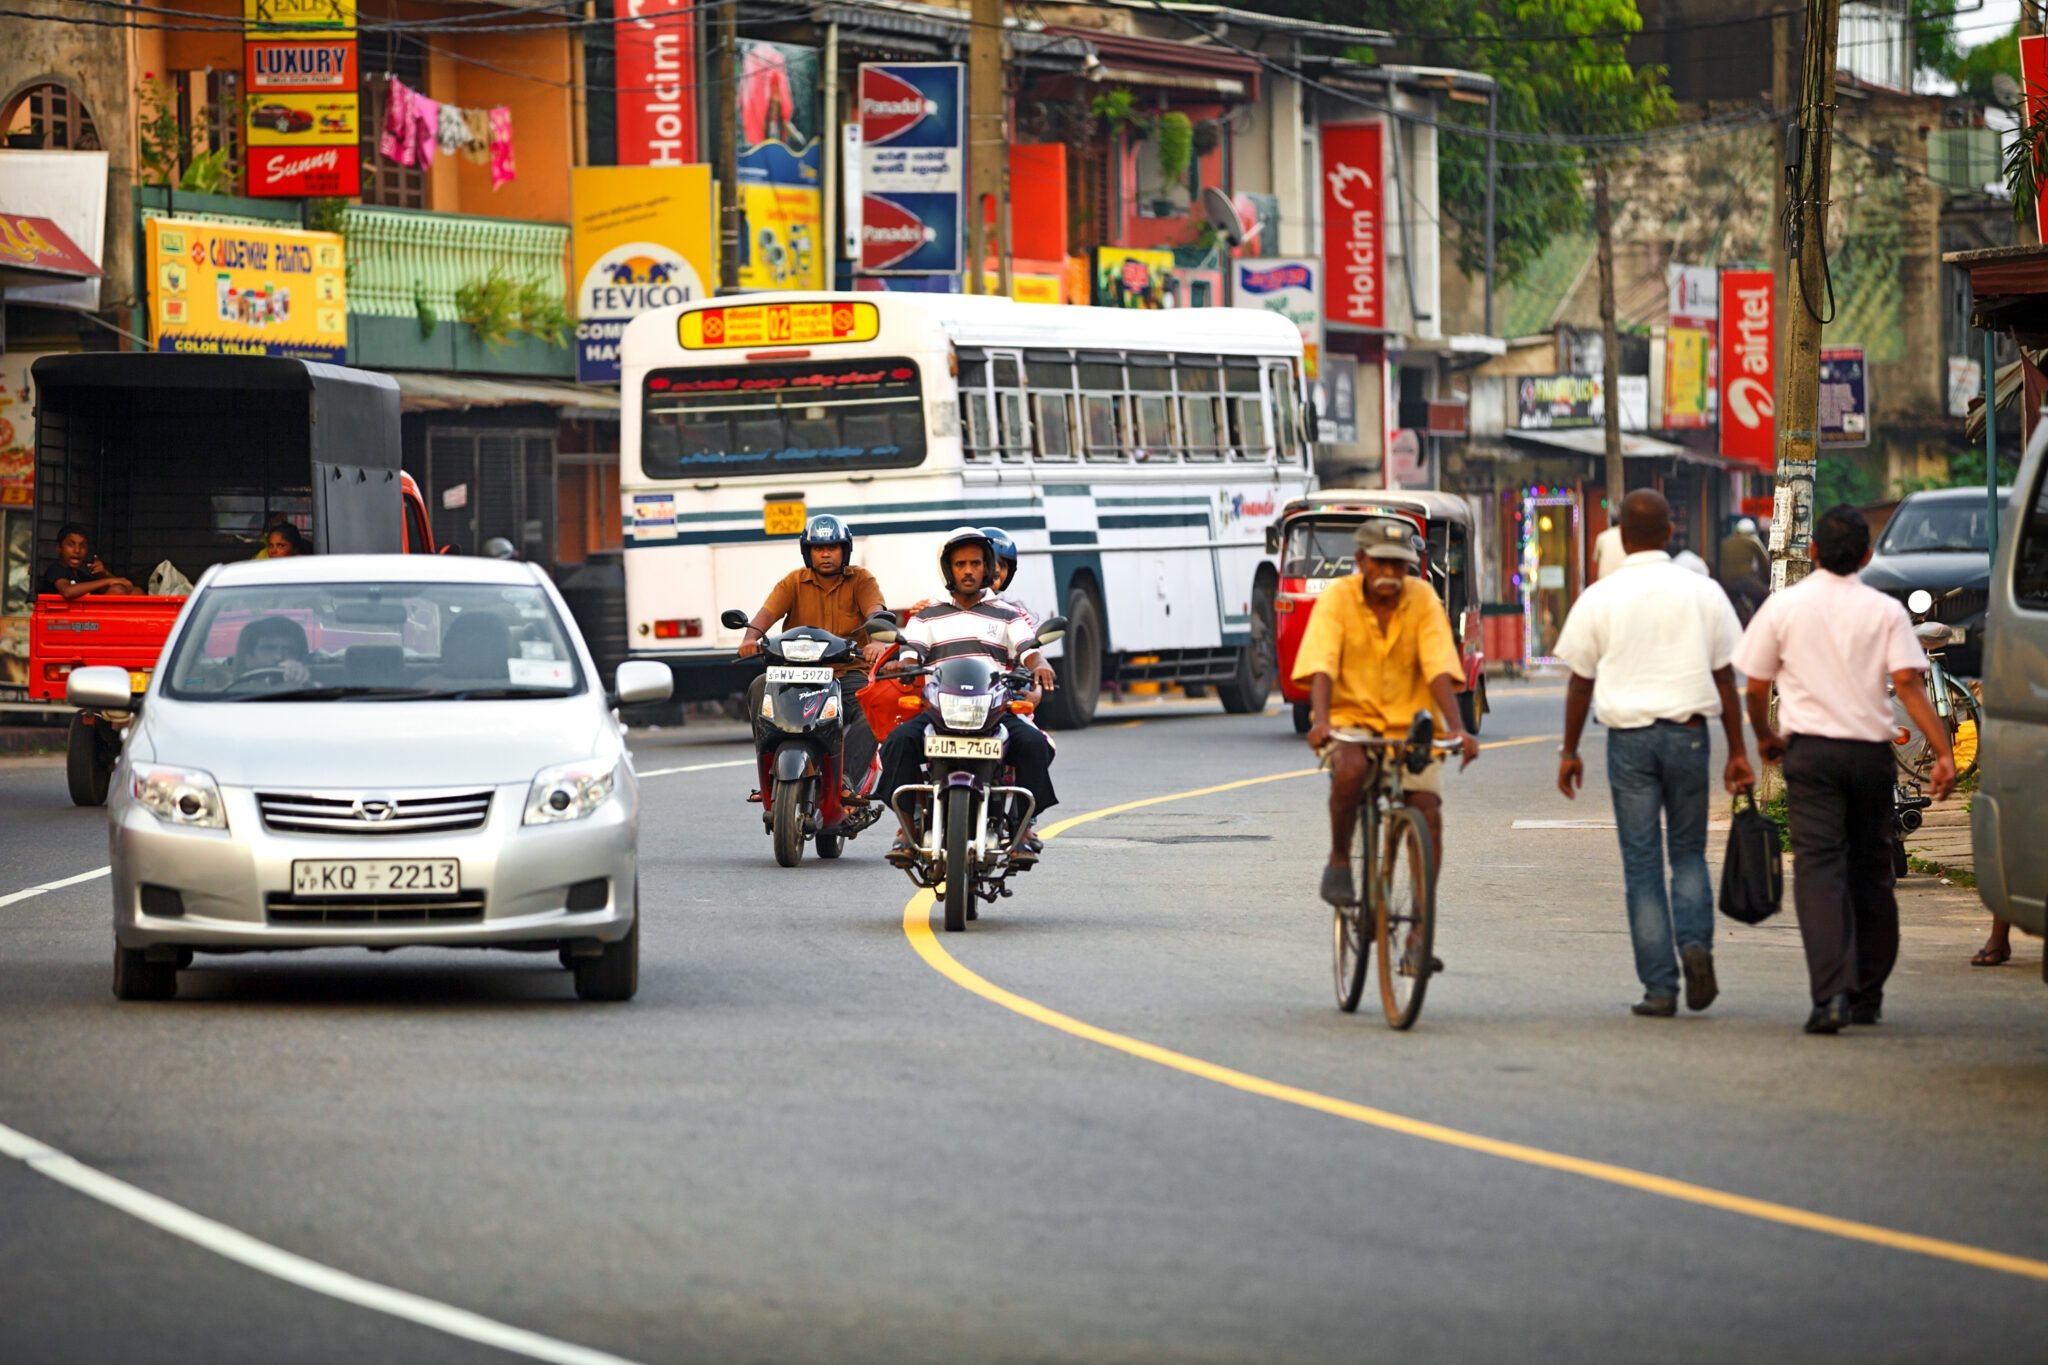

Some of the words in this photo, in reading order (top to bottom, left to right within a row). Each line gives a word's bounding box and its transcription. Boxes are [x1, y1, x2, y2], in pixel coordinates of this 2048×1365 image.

[255, 47, 346, 74] LUXURY
[645, 34, 682, 168] Holcim
[862, 97, 923, 115] Panadol
[266, 149, 338, 184] Sunny
[1345, 210, 1374, 318] Holcim
[769, 309, 790, 338] 02
[1734, 286, 1770, 375] airtel
[174, 340, 219, 353] COLOR
[222, 341, 267, 356] VILLAS
[585, 344, 621, 361] HA
